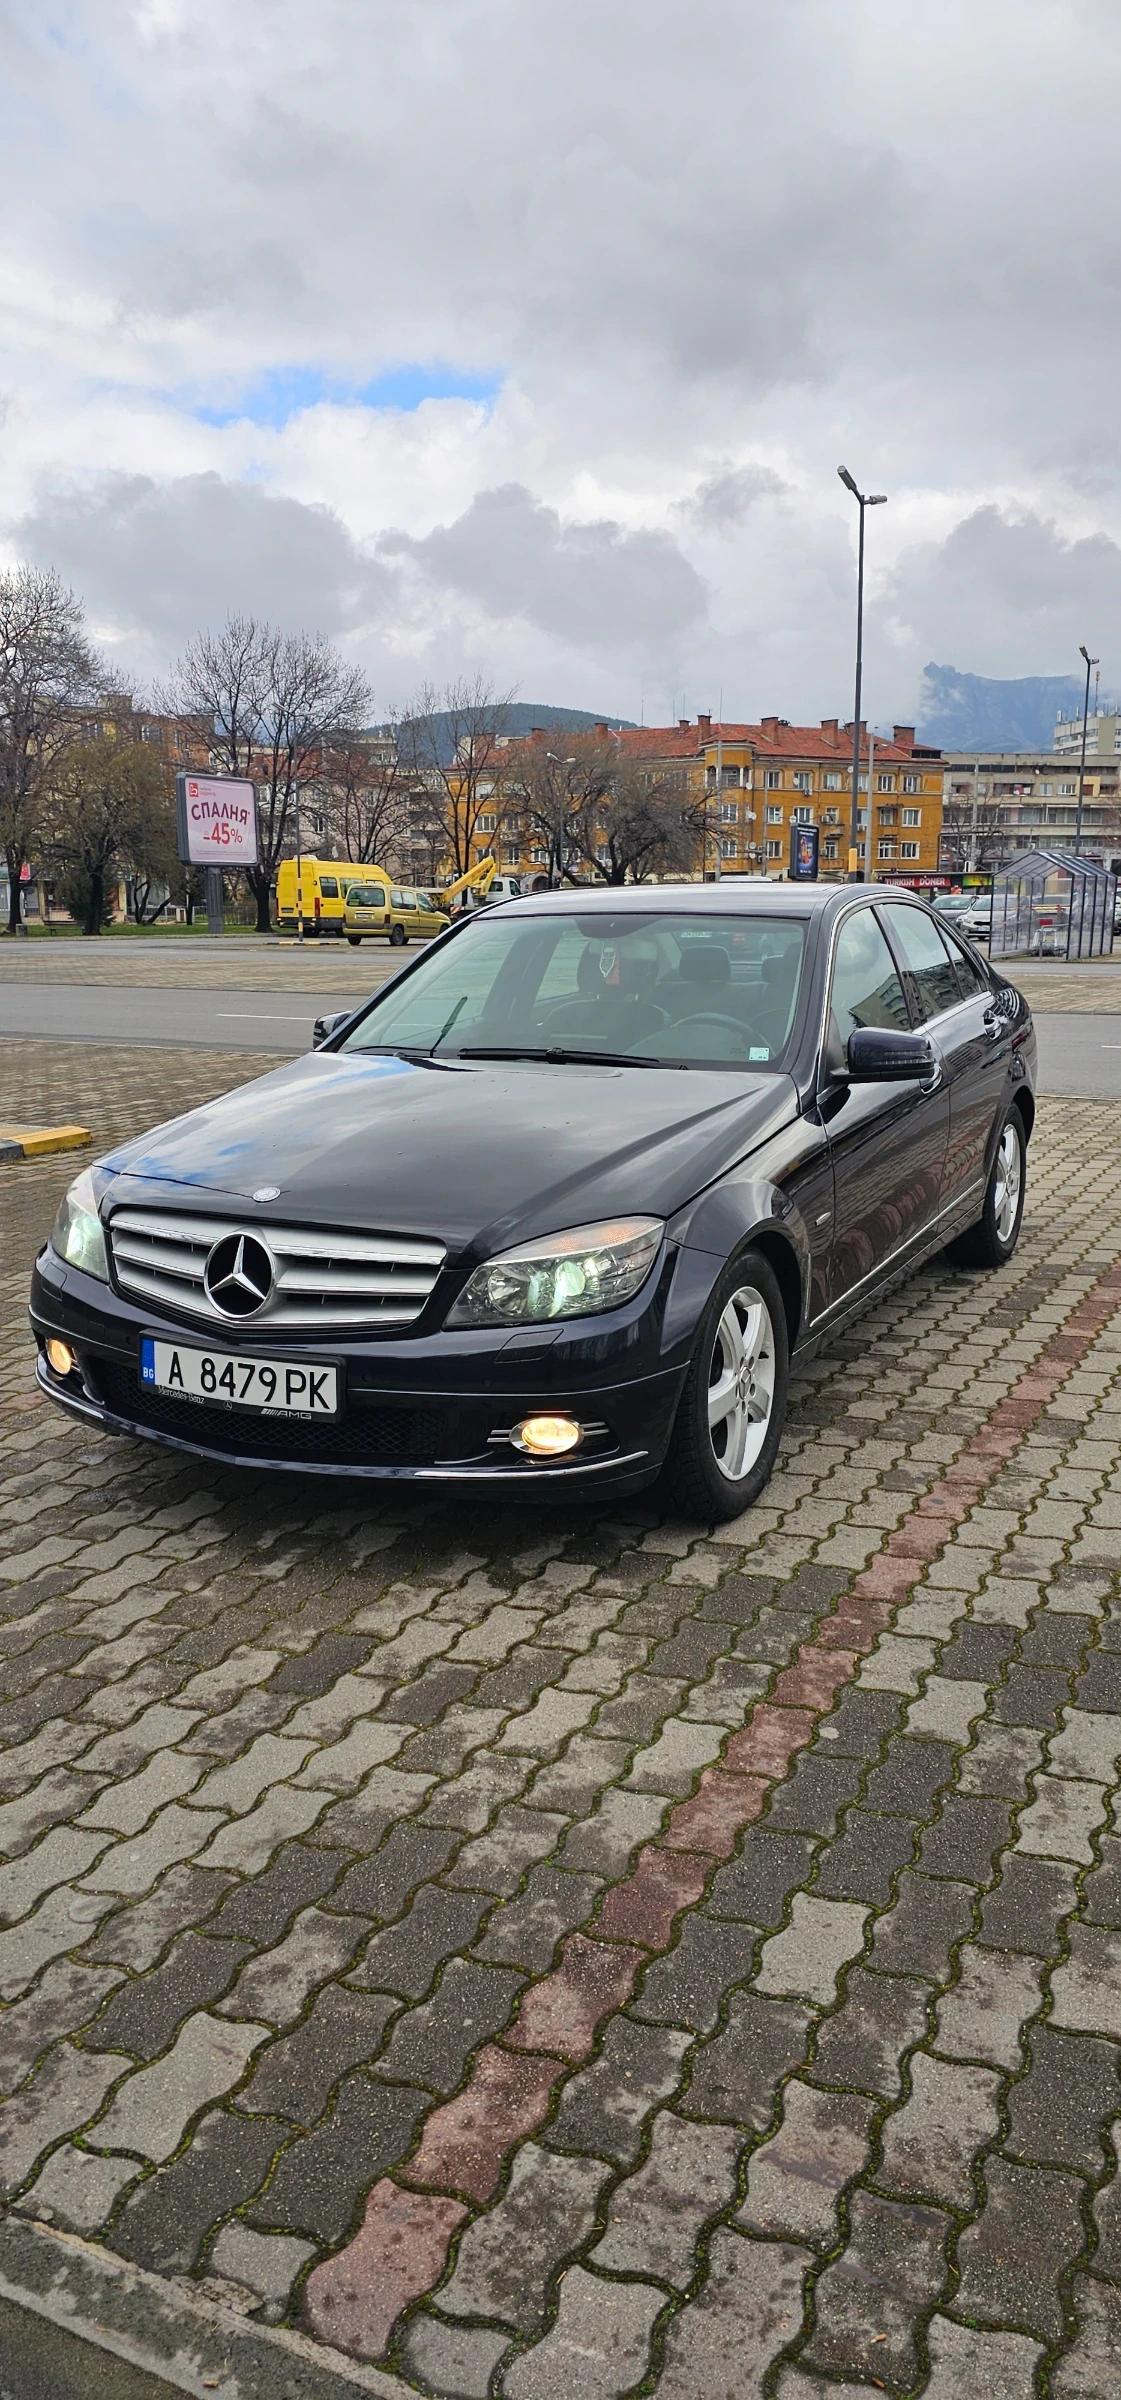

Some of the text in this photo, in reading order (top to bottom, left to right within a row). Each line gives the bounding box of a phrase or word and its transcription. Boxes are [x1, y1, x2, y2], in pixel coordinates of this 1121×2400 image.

[203, 822, 243, 845] -45%
[885, 877, 915, 886] TURKISH
[143, 1367, 154, 1379] BG
[168, 1351, 184, 1387] A
[157, 1384, 205, 1405] Mercedes-Benz
[277, 1410, 312, 1420] AMG
